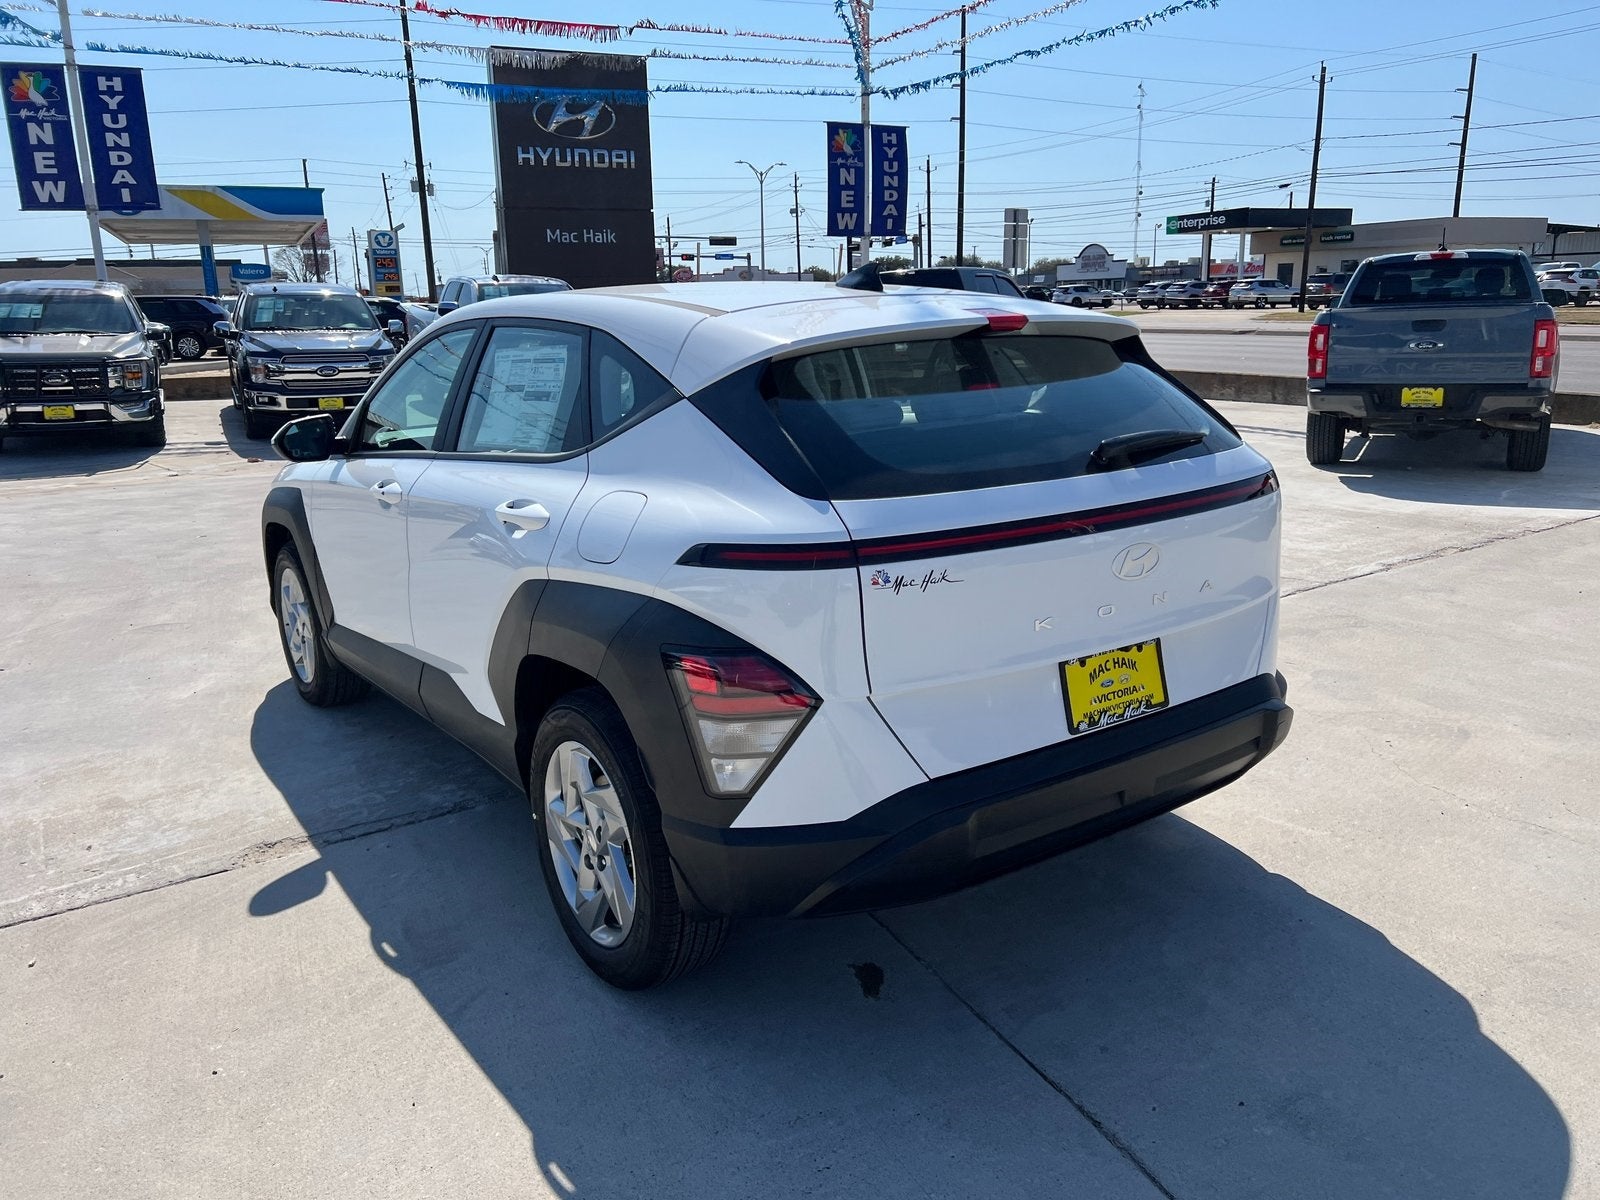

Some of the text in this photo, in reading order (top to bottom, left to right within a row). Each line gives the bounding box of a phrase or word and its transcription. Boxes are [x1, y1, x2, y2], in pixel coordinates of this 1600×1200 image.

[97, 76, 137, 203] HYUNDAI
[26, 122, 66, 203] NEW
[517, 146, 636, 169] HYUNDAI
[882, 132, 899, 230] HYUNDAI
[836, 168, 857, 230] NEW
[1169, 214, 1226, 230] enterprise
[546, 229, 617, 243] Mac Haik
[238, 267, 265, 275] Valero
[888, 568, 964, 595] Mac Haik
[1034, 579, 1213, 631] KONA
[1089, 657, 1139, 685] MAC HAIK
[1096, 685, 1139, 704] VICTORIA
[1097, 700, 1155, 727] Mac Haik
